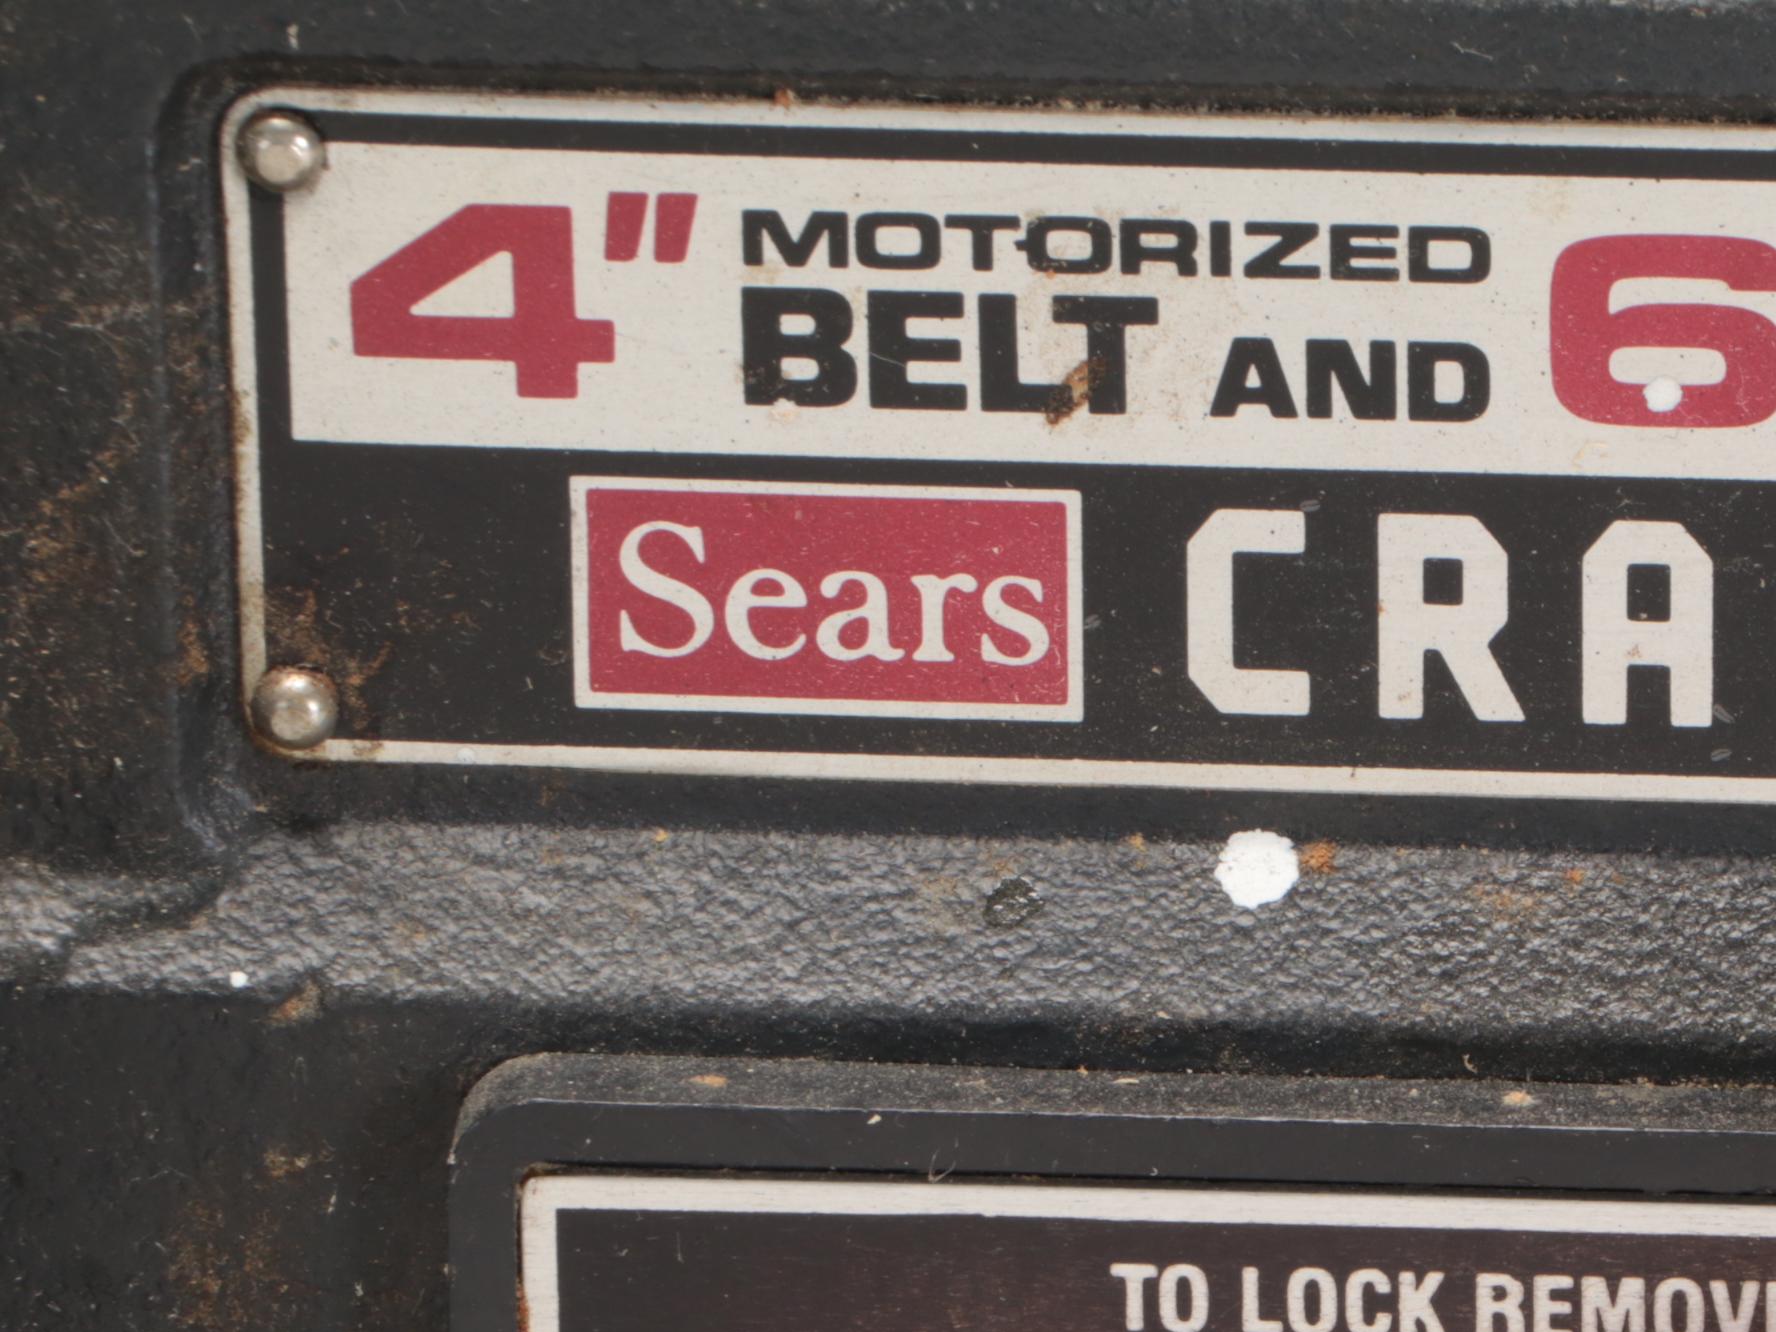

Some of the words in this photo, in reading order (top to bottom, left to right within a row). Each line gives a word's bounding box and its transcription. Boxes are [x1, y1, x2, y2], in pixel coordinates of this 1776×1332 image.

[352, 193, 697, 399] 4"
[743, 210, 1490, 283] MOTORIZED
[742, 287, 1158, 416] BELT
[1211, 338, 1489, 421] AND
[619, 520, 1050, 666] Sears
